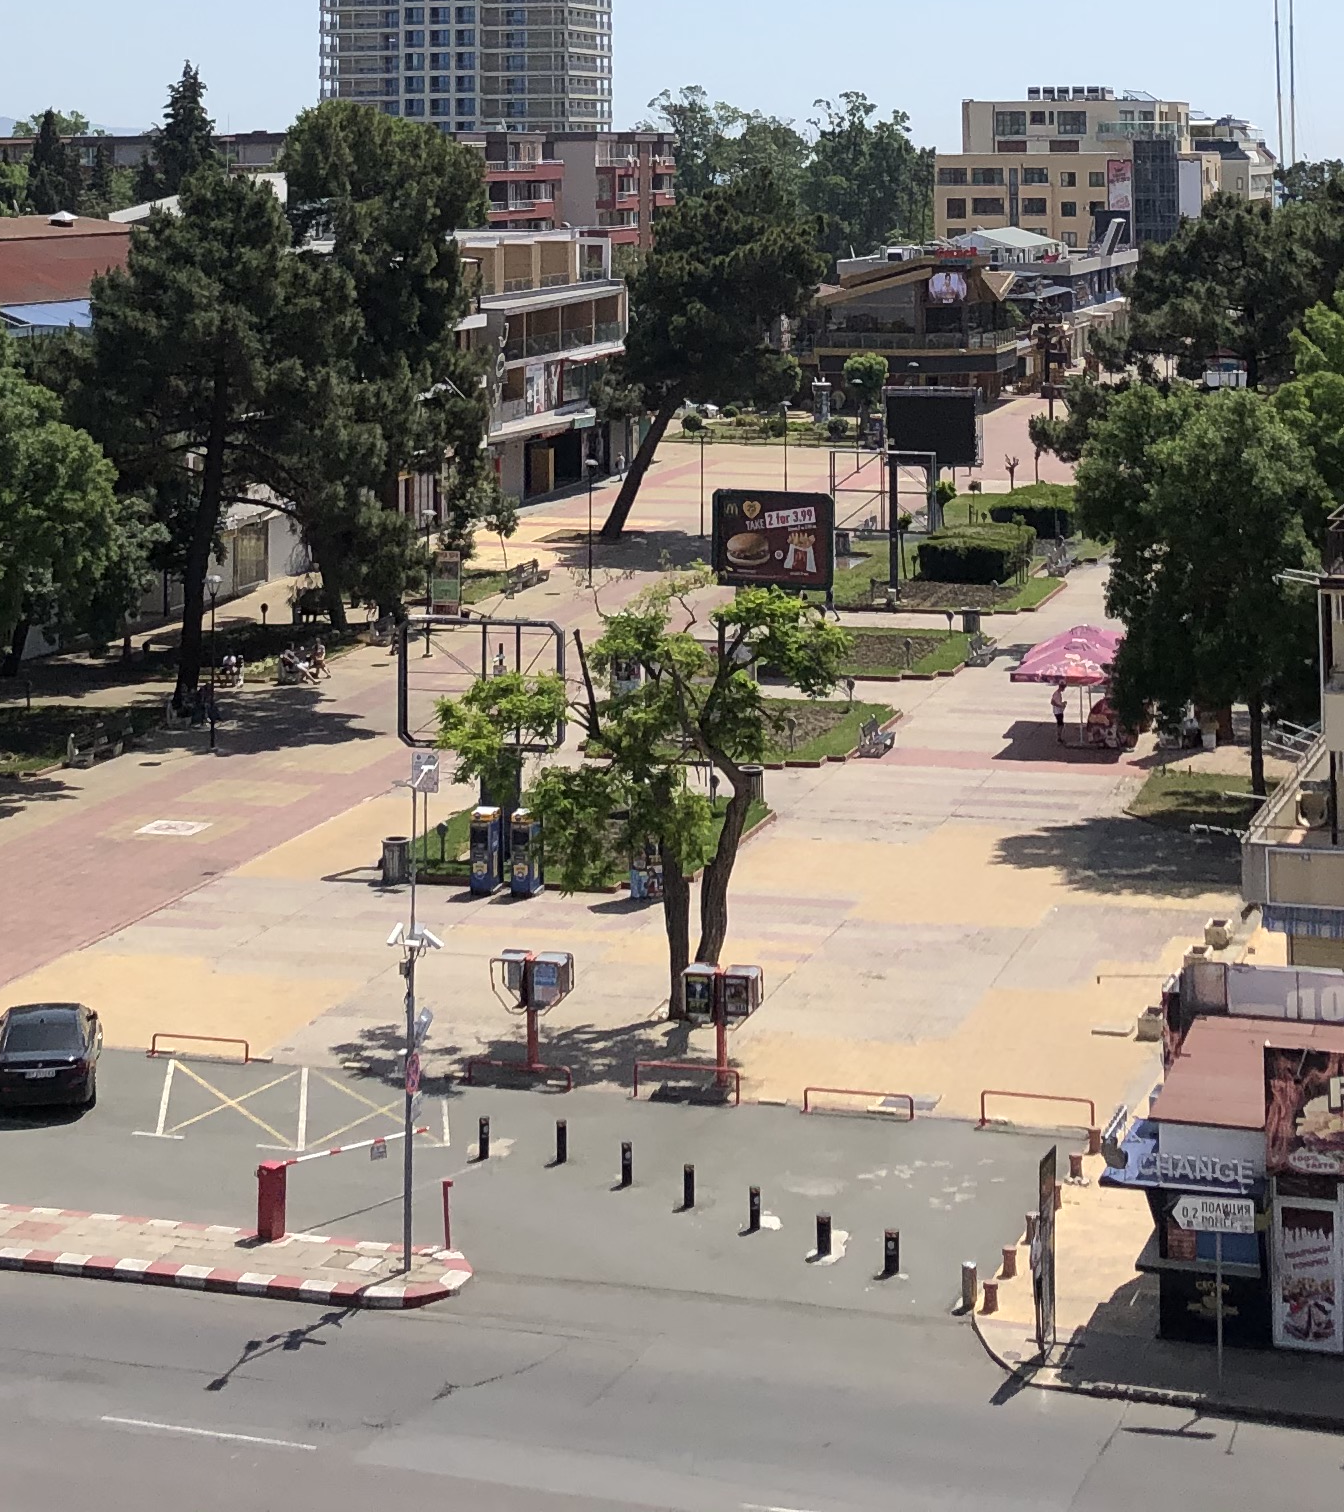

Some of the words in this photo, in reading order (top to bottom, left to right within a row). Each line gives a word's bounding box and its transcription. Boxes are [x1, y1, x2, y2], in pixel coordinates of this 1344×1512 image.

[745, 518, 765, 530] TAKE
[767, 514, 774, 526] 2
[792, 509, 813, 523] 3.99
[1139, 1153, 1255, 1185] CHANGE
[1201, 1201, 1251, 1216] ПОЛИЦИЯ
